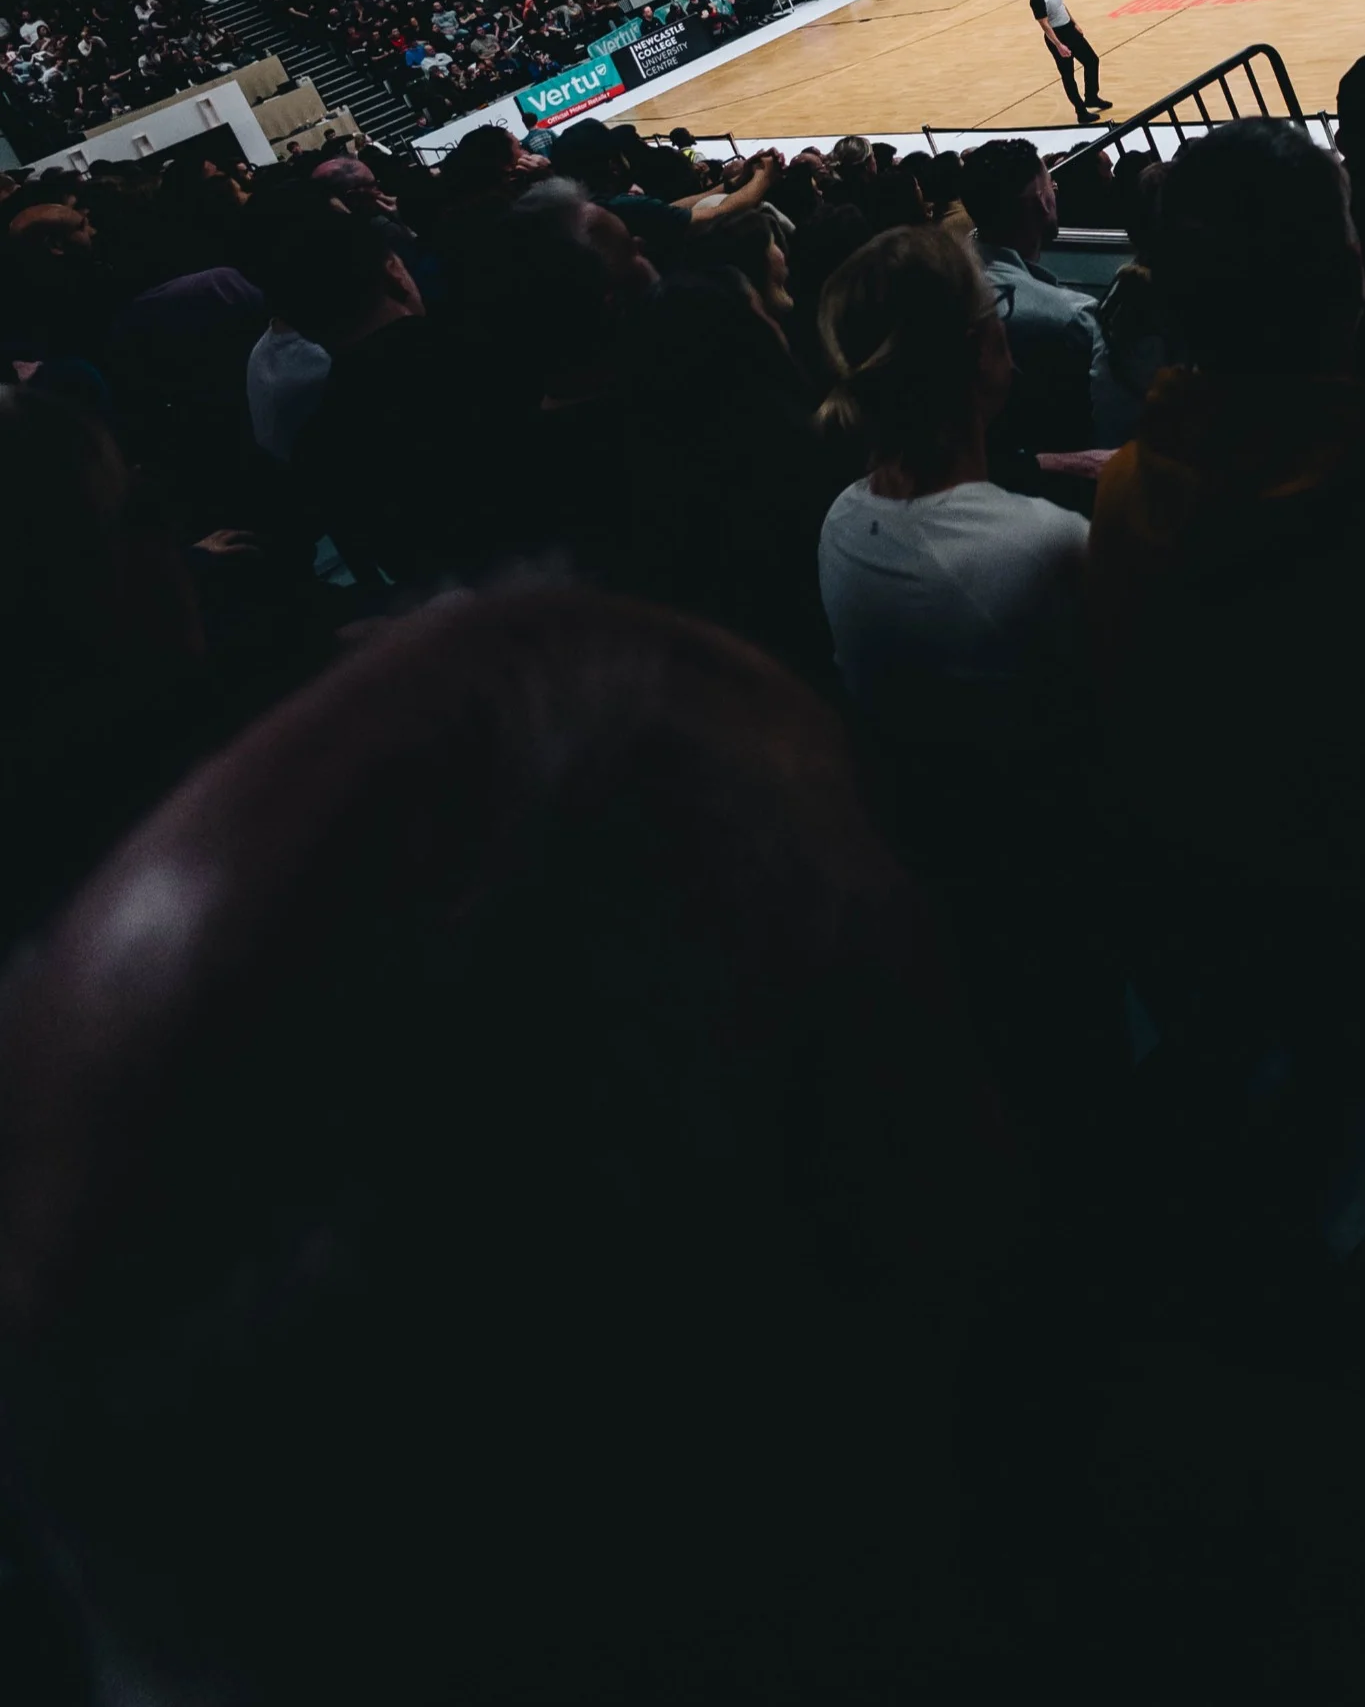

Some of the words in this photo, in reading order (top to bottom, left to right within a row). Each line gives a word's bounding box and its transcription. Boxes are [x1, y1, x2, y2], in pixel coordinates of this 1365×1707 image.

[633, 22, 686, 51] NEWCASTLE
[637, 36, 679, 61] COLLEGE
[641, 41, 689, 69] UNIVERSITY
[645, 56, 679, 77] CENTRE
[527, 69, 601, 113] Vertu
[546, 109, 570, 125] Official
[569, 100, 588, 115] Motor
